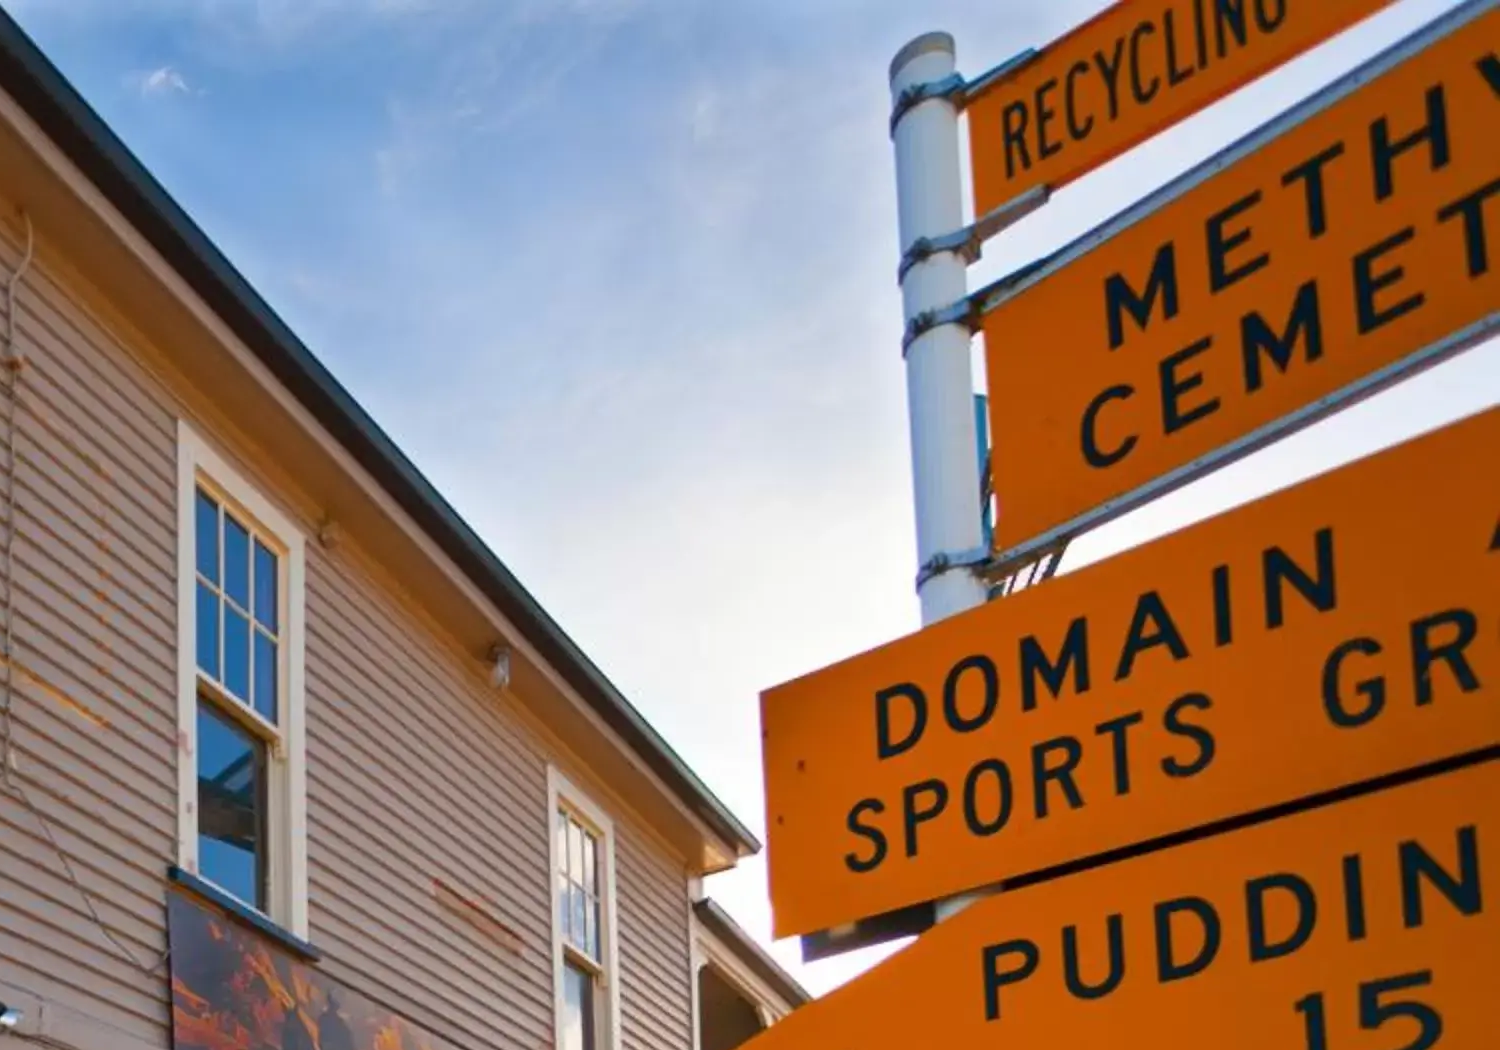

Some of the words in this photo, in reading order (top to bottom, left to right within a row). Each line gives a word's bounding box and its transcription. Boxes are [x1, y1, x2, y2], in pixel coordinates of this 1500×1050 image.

[875, 527, 1337, 759] DOMAIN
[844, 692, 1217, 873] SPORTS
[982, 824, 1484, 1020] PUDDIN
